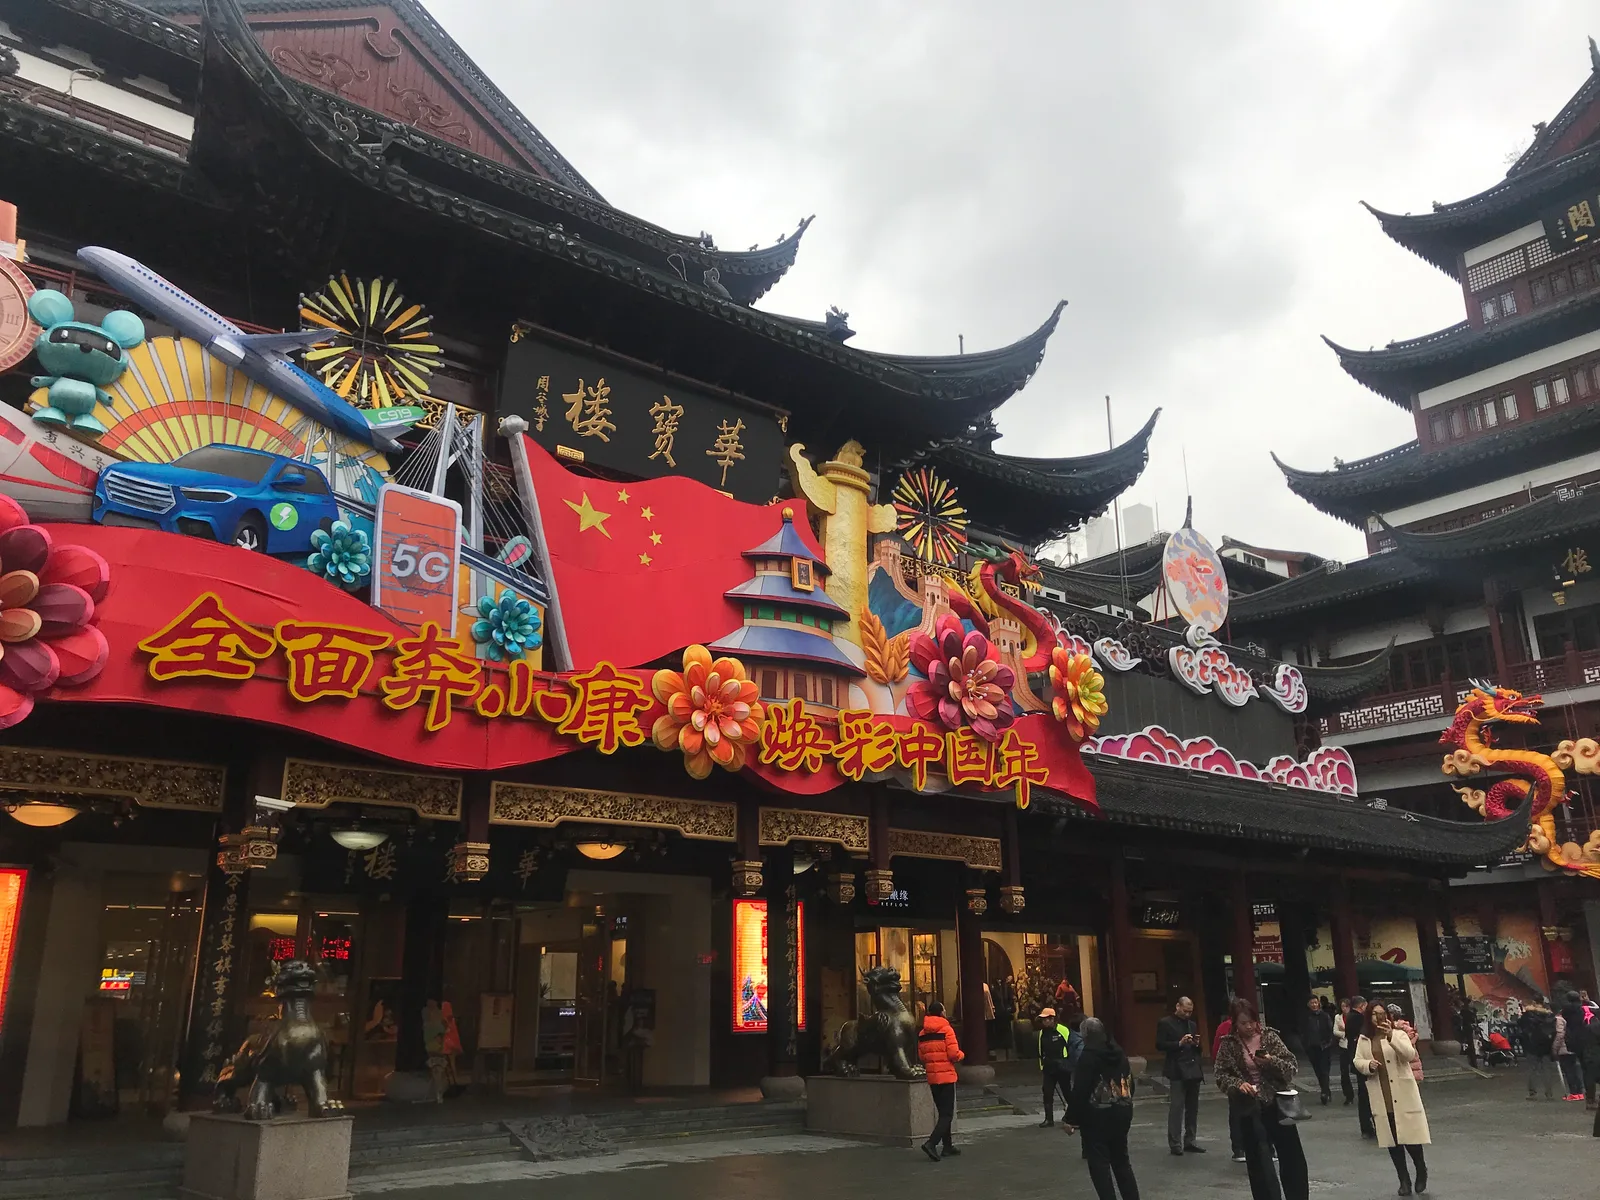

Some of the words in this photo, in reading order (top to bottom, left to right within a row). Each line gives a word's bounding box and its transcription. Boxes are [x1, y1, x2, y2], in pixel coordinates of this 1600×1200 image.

[378, 408, 412, 421] C919
[391, 543, 450, 583] 5G
[138, 591, 655, 754] 全面奔小康
[758, 697, 1050, 809] 焕彩中国年
